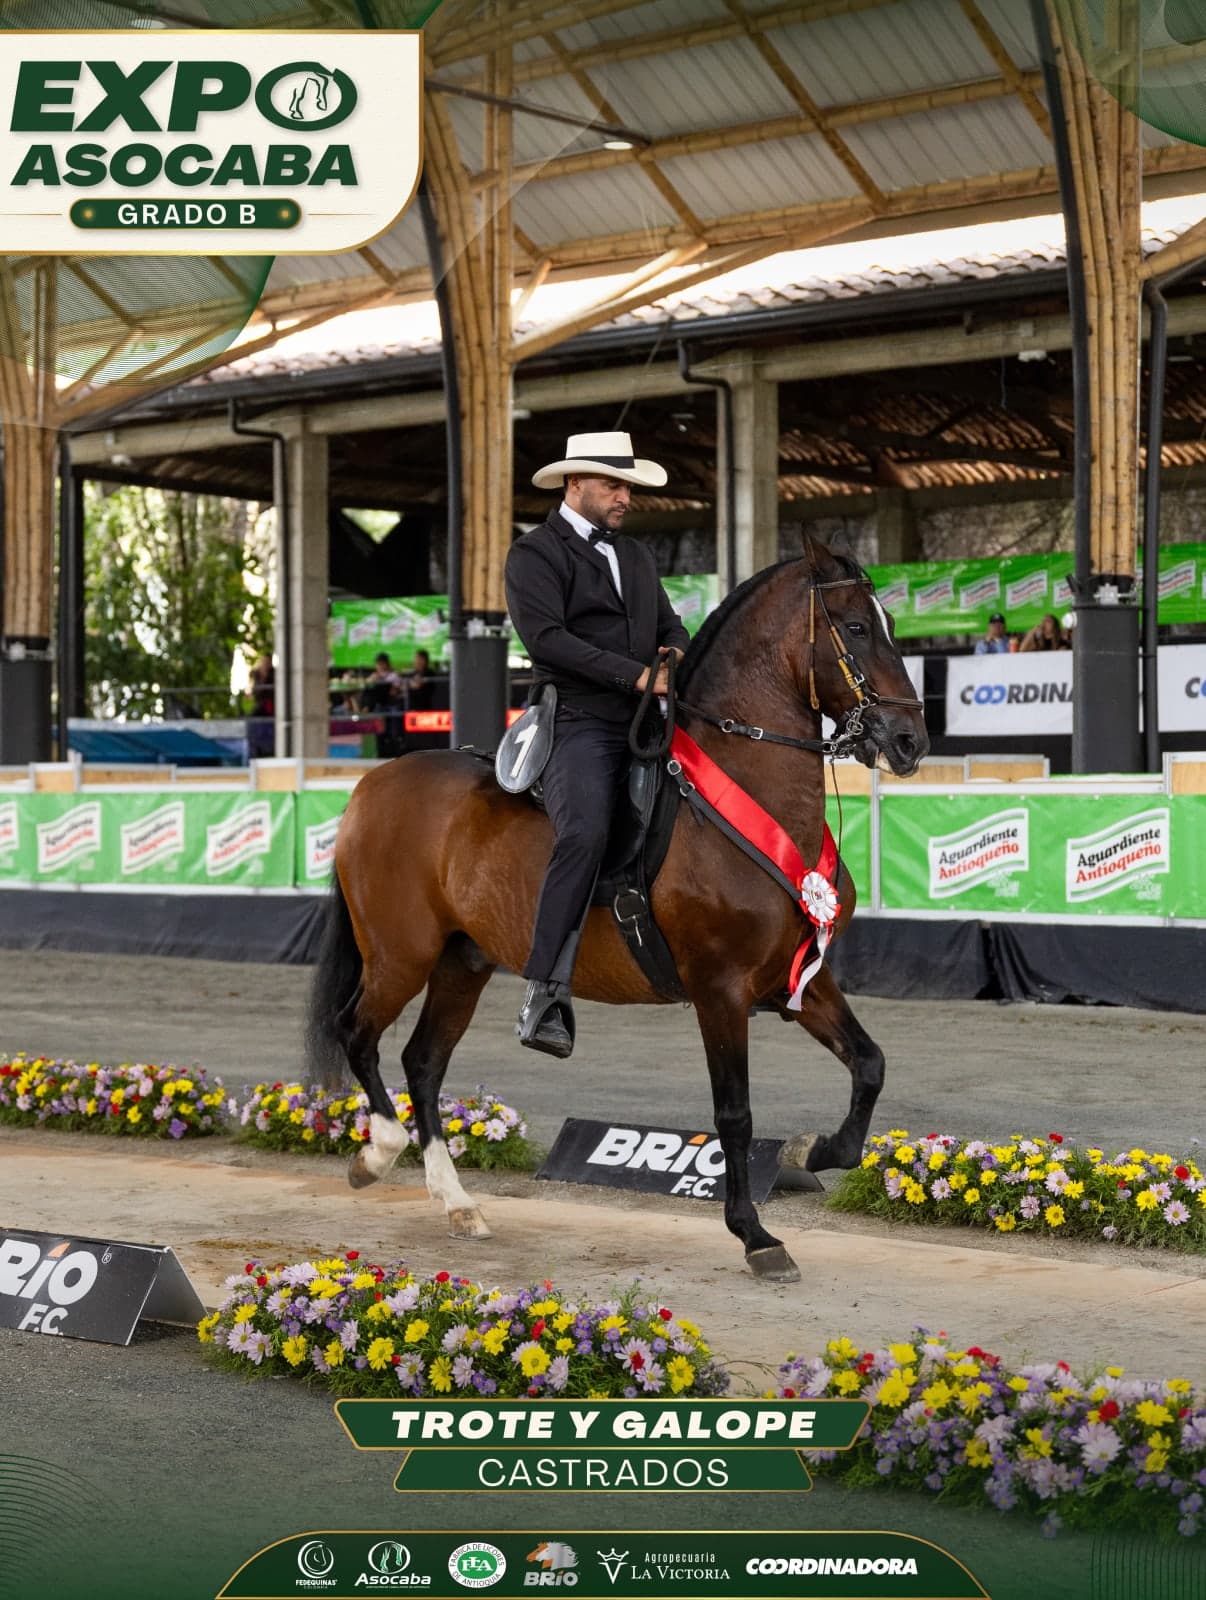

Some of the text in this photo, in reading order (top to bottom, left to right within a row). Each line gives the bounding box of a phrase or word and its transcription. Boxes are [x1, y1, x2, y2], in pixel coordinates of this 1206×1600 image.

[960, 682, 1073, 705] COORDIN
[514, 723, 539, 778] 1
[938, 826, 1018, 865] Aguardiente
[938, 839, 1020, 881] Antioqueño
[1075, 840, 1162, 884] Antioqueño
[1077, 827, 1161, 867] Aguardiente
[670, 1175, 718, 1198] F.C.
[18, 1302, 69, 1336] F.C.
